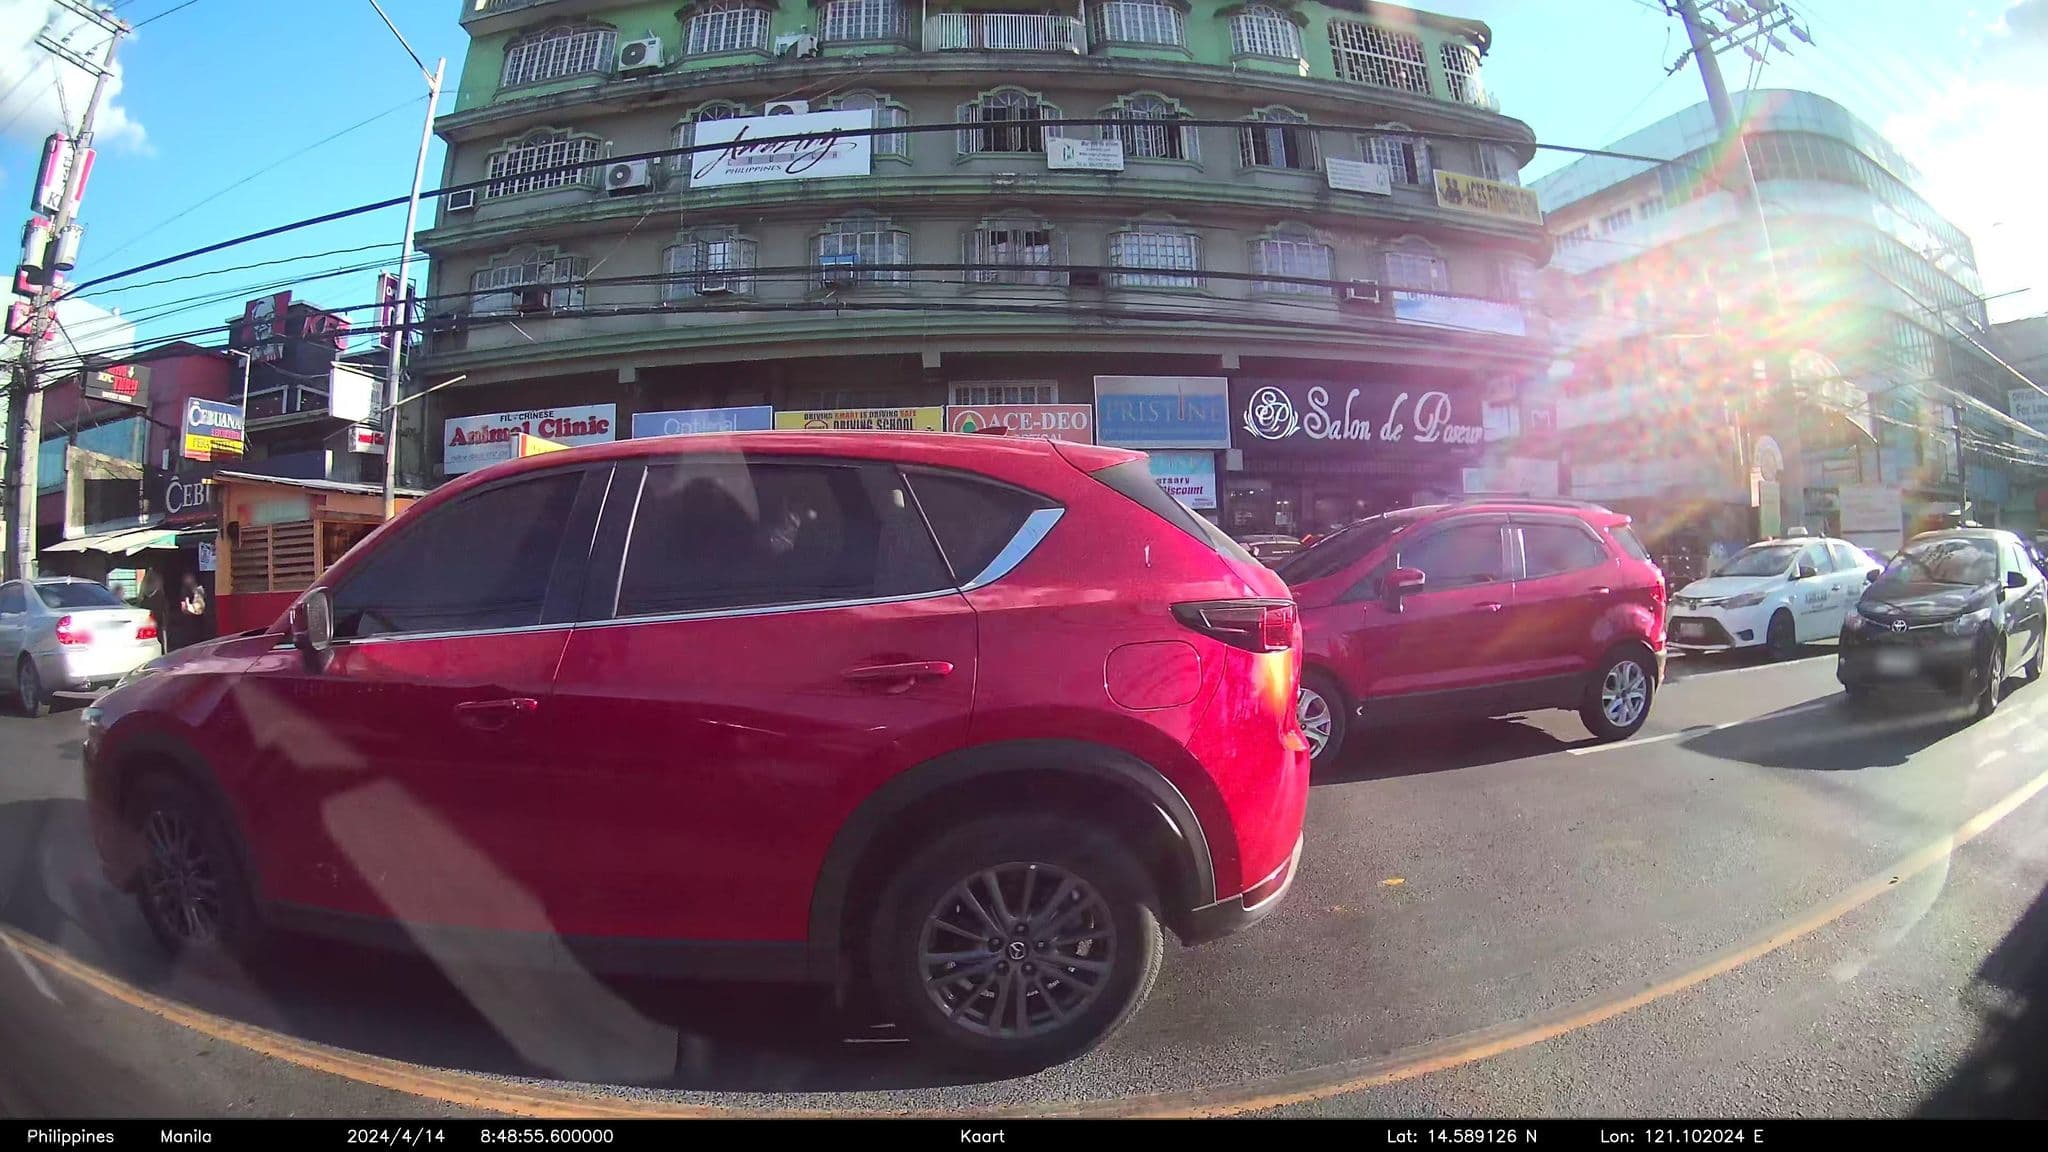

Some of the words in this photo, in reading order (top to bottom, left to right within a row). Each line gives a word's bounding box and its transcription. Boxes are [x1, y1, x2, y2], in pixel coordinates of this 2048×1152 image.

[725, 164, 782, 175] PHILIPPINES
[1106, 399, 1223, 422] PRISTINE
[1304, 386, 1371, 440] Salon
[1380, 392, 1408, 441] de
[538, 416, 609, 438] Clinic
[833, 420, 872, 430] DRIVING
[876, 418, 914, 430] SCHOOL
[989, 412, 1088, 430] ACE-DEO
[1164, 486, 1203, 495] iscount
